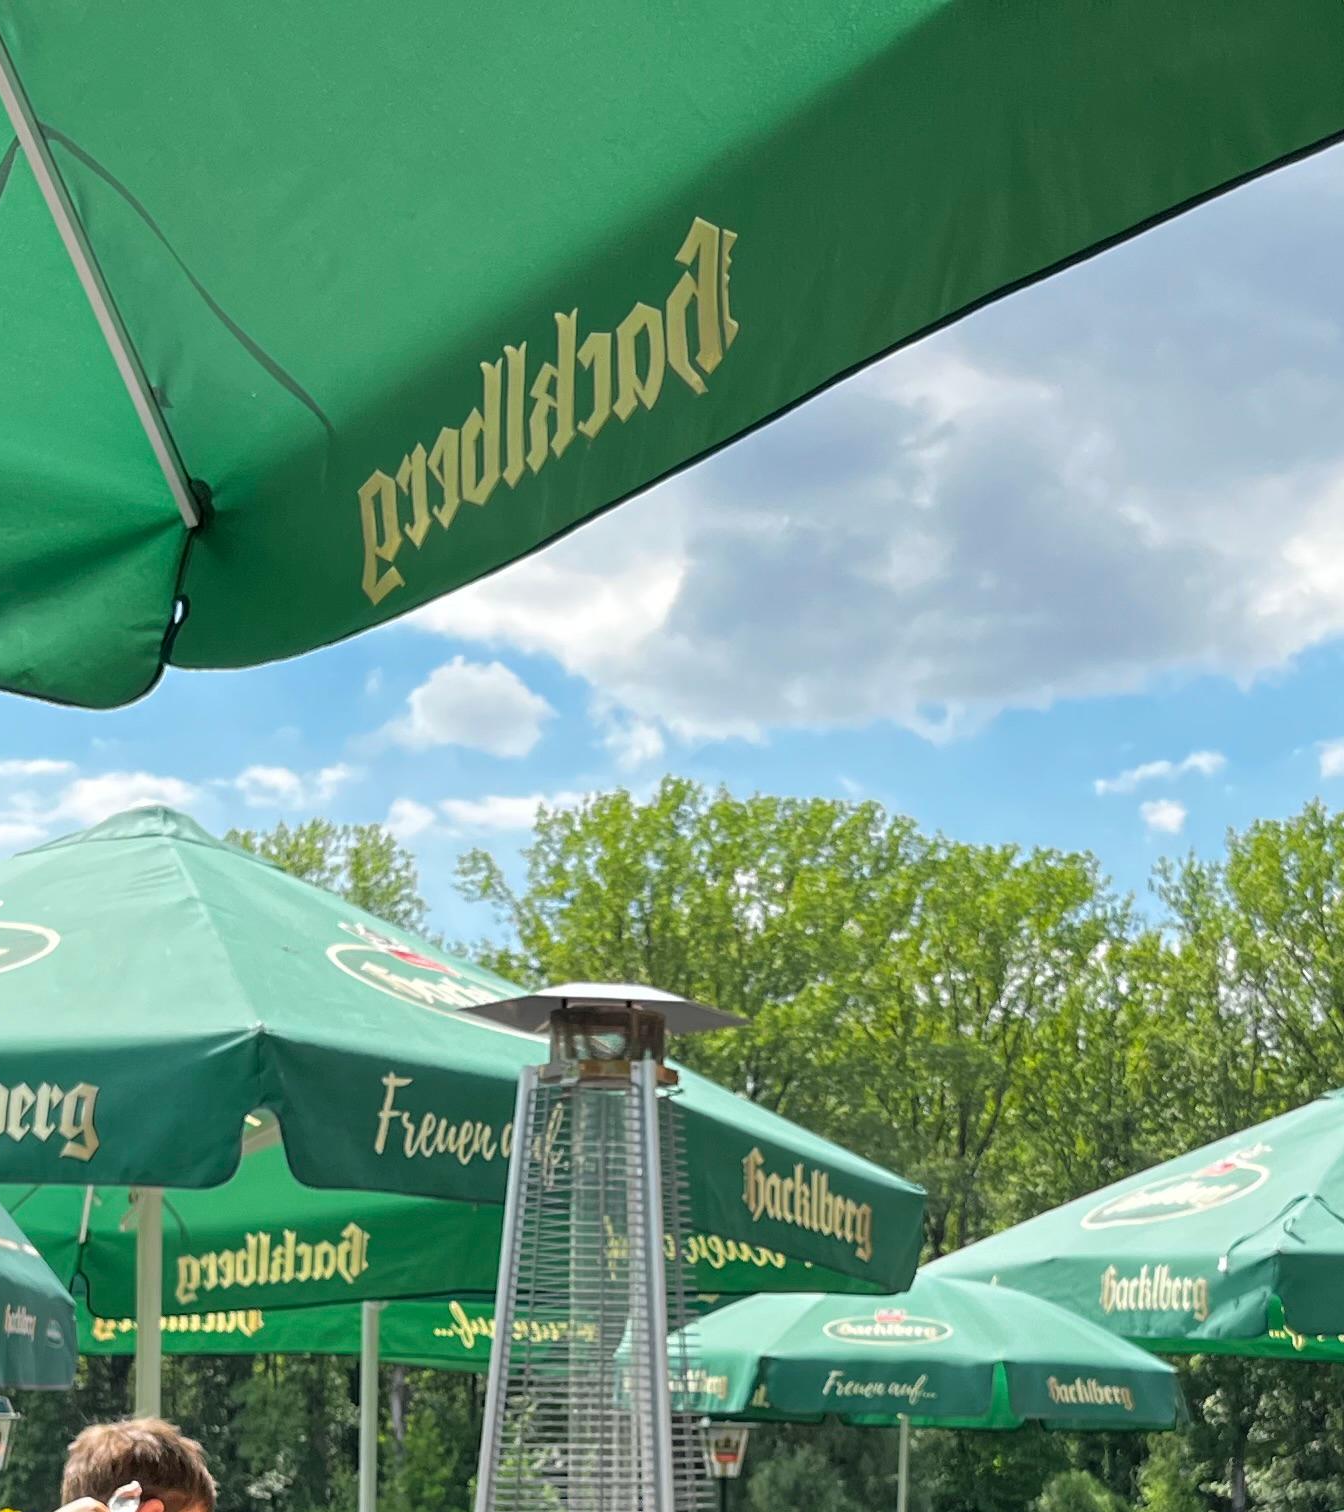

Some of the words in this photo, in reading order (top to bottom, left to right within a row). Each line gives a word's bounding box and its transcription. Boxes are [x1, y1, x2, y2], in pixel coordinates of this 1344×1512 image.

[375, 1071, 497, 1165] Freuen
[742, 1146, 872, 1263] Hacklberg
[1100, 1264, 1209, 1322] Hacklberg
[822, 1369, 887, 1399] Freuen
[1047, 1375, 1135, 1412] Hacklberg
